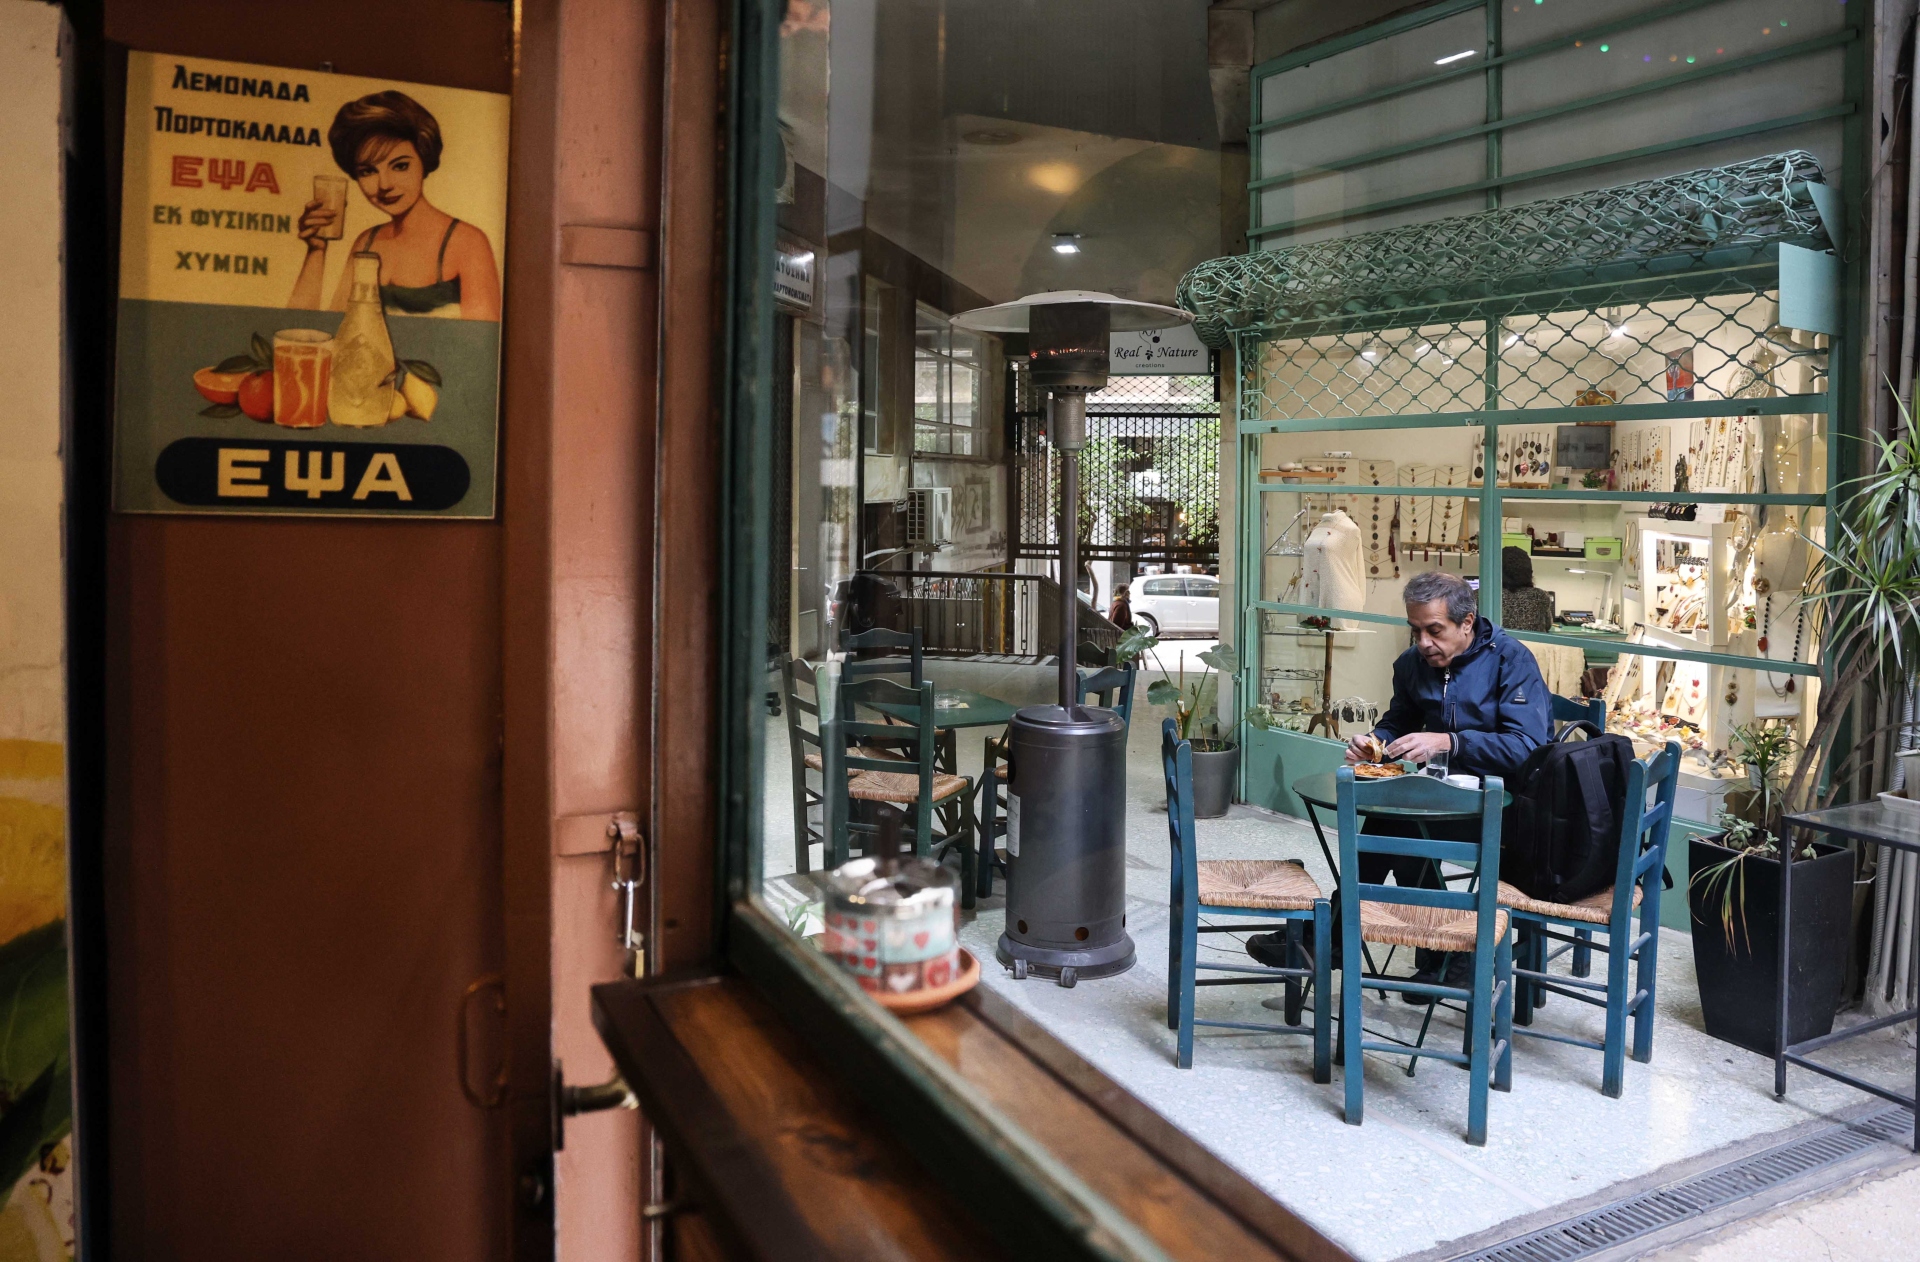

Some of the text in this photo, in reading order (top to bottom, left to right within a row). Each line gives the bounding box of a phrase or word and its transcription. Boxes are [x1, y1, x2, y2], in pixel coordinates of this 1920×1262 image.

[172, 64, 310, 103] ΛΕΜΟΝΑΔΑ
[154, 105, 322, 147] ΠΟΡΤΟΚΑΛΑΔΑ
[171, 155, 280, 195] ΕΨΑ
[153, 204, 182, 225] ΕΚ
[1114, 345, 1199, 360] Real Nature
[217, 447, 413, 502] ΕΨΑ
